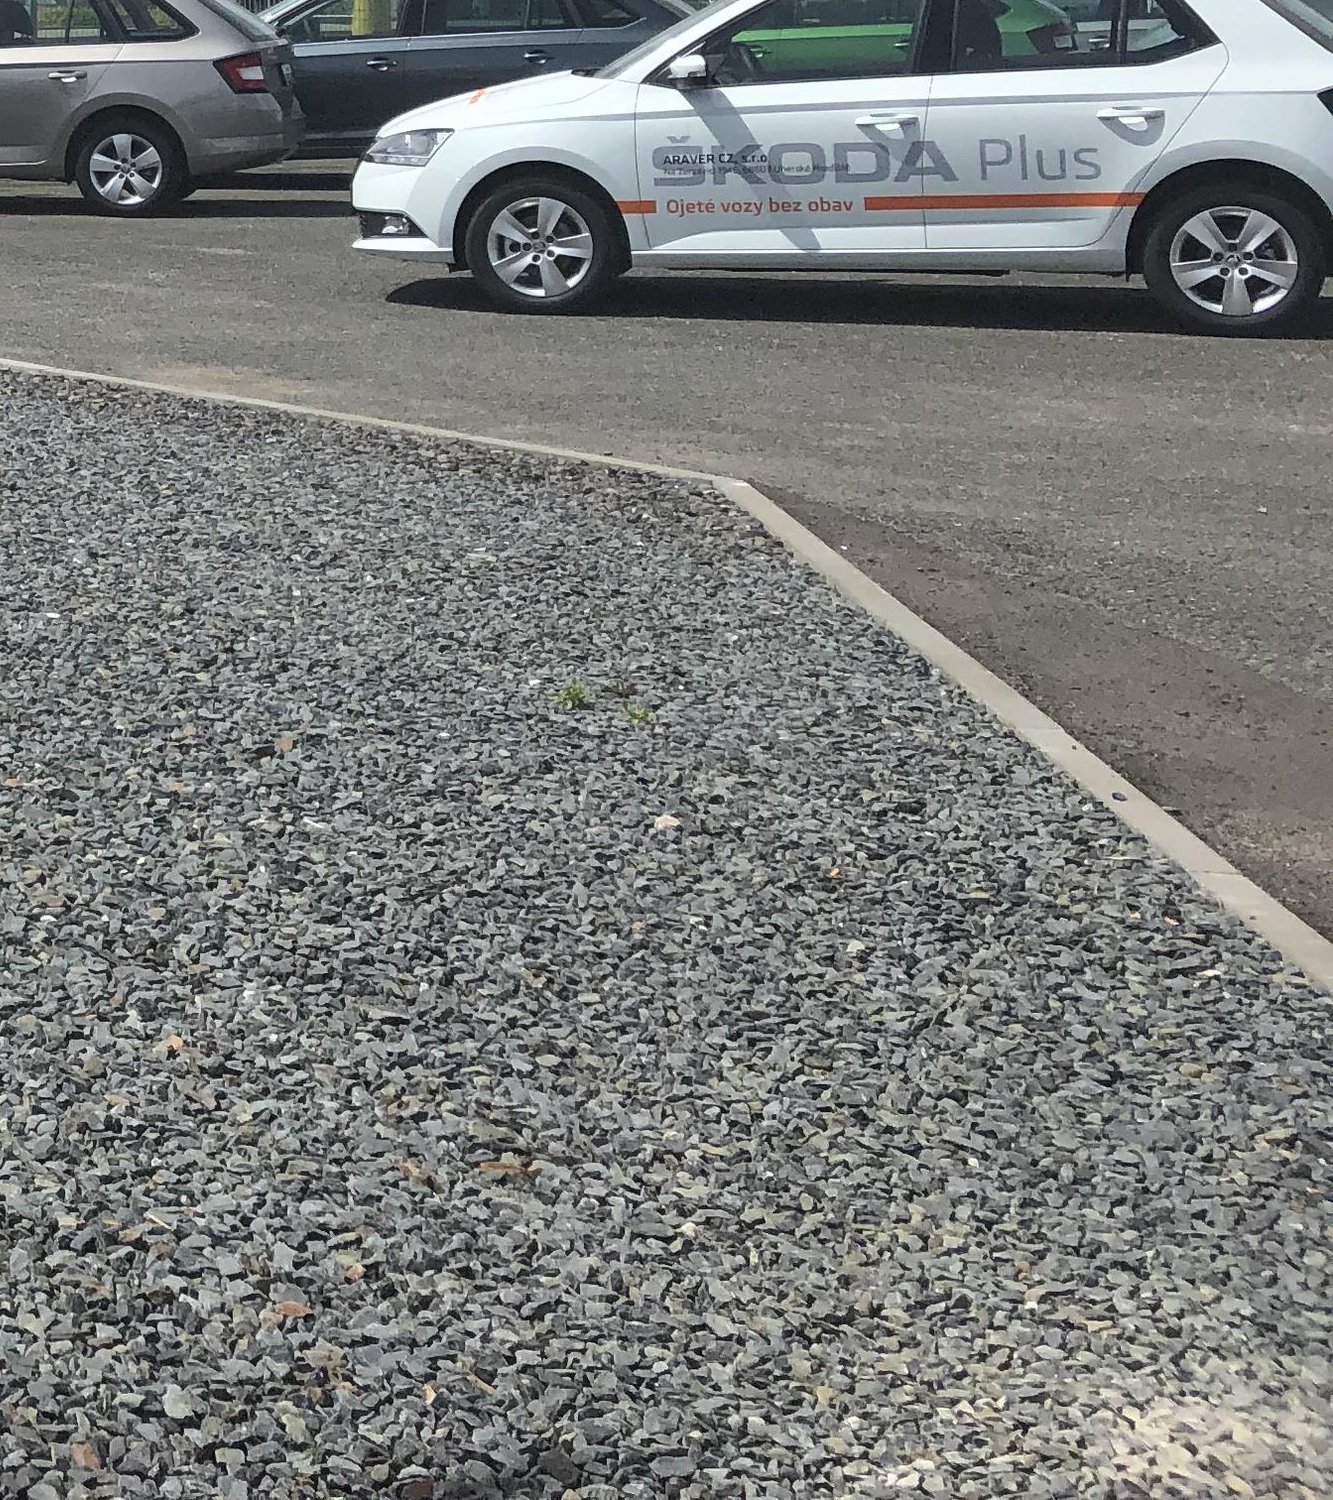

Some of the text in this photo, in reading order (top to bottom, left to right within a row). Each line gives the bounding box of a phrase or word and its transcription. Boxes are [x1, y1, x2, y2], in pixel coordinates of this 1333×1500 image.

[652, 134, 1102, 187] ŠKODA Plus
[663, 154, 715, 165] ARAVER
[666, 196, 854, 217] Ojeté vozy bez obav
